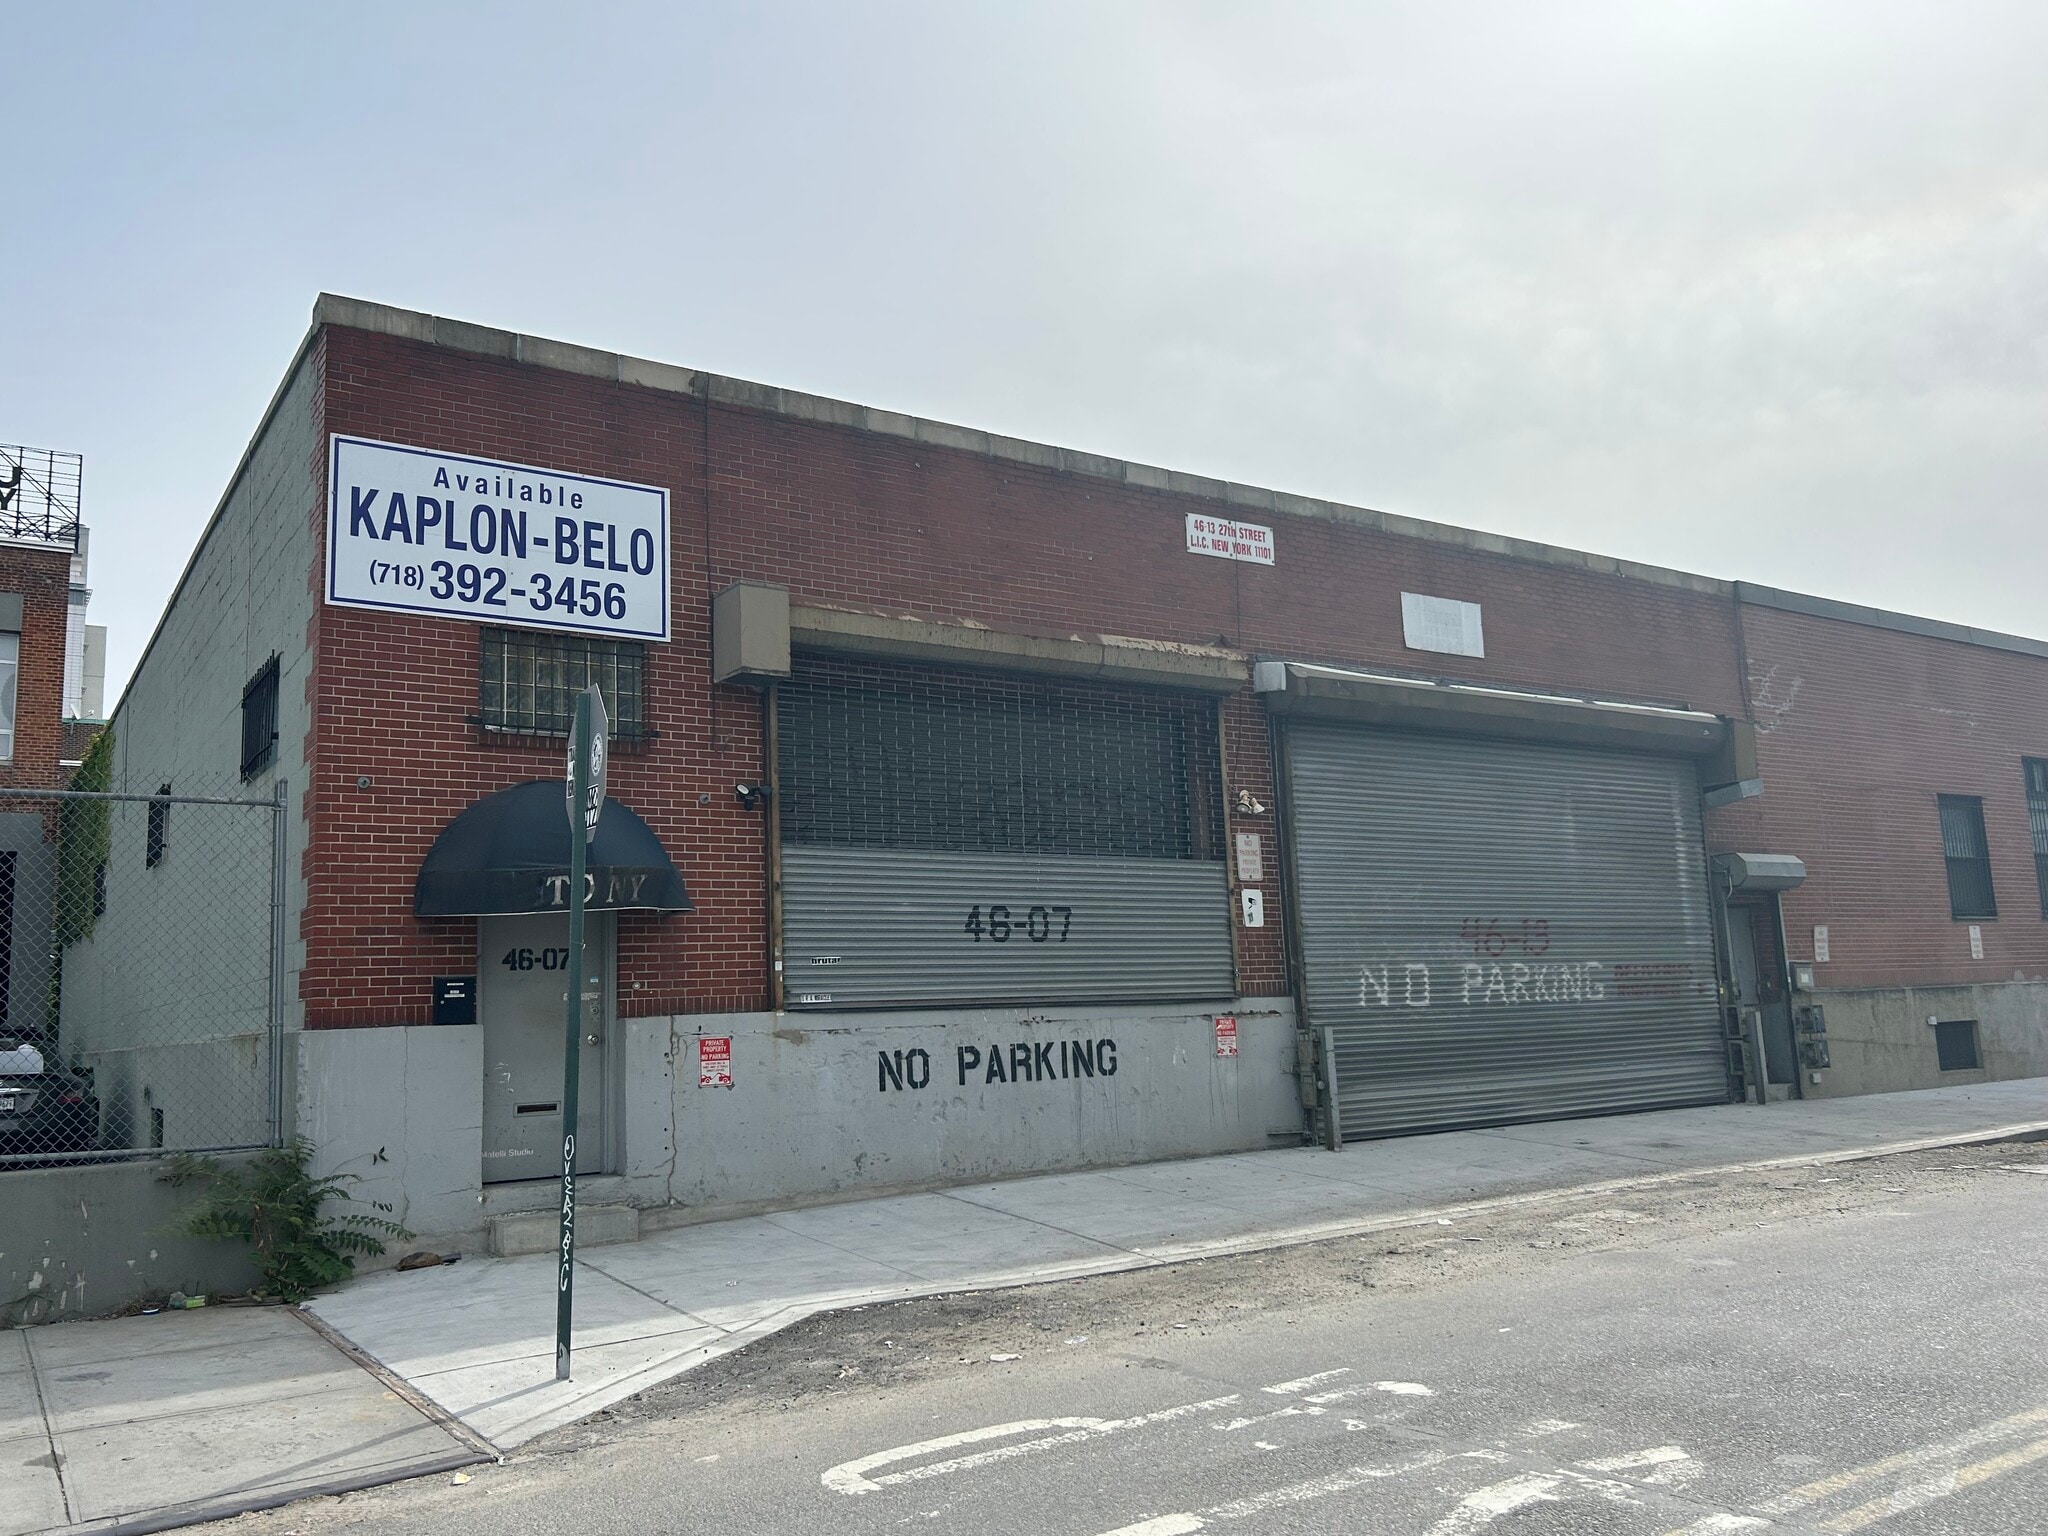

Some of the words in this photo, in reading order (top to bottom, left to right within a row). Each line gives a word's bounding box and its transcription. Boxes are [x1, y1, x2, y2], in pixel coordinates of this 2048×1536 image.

[434, 467, 583, 509] Available
[350, 486, 655, 576] KAPLON-BELO
[1190, 535, 1209, 549] L.I.C.
[1212, 539, 1229, 552] NEW
[1232, 542, 1252, 556] YORK
[1255, 546, 1271, 559] 11101
[1194, 519, 1216, 534] 46-13
[1218, 524, 1236, 538] 27th
[1239, 527, 1266, 543] STREET
[370, 559, 424, 591] (718)
[429, 560, 626, 619] 392-3456
[963, 905, 1073, 943] 46-07
[1460, 917, 1550, 957] 46-13
[502, 948, 570, 971] 46-07
[1359, 963, 1430, 1007] NO
[1462, 961, 1604, 1005] PARKING
[878, 1048, 931, 1092] NO
[957, 1039, 1118, 1086] PARKING
